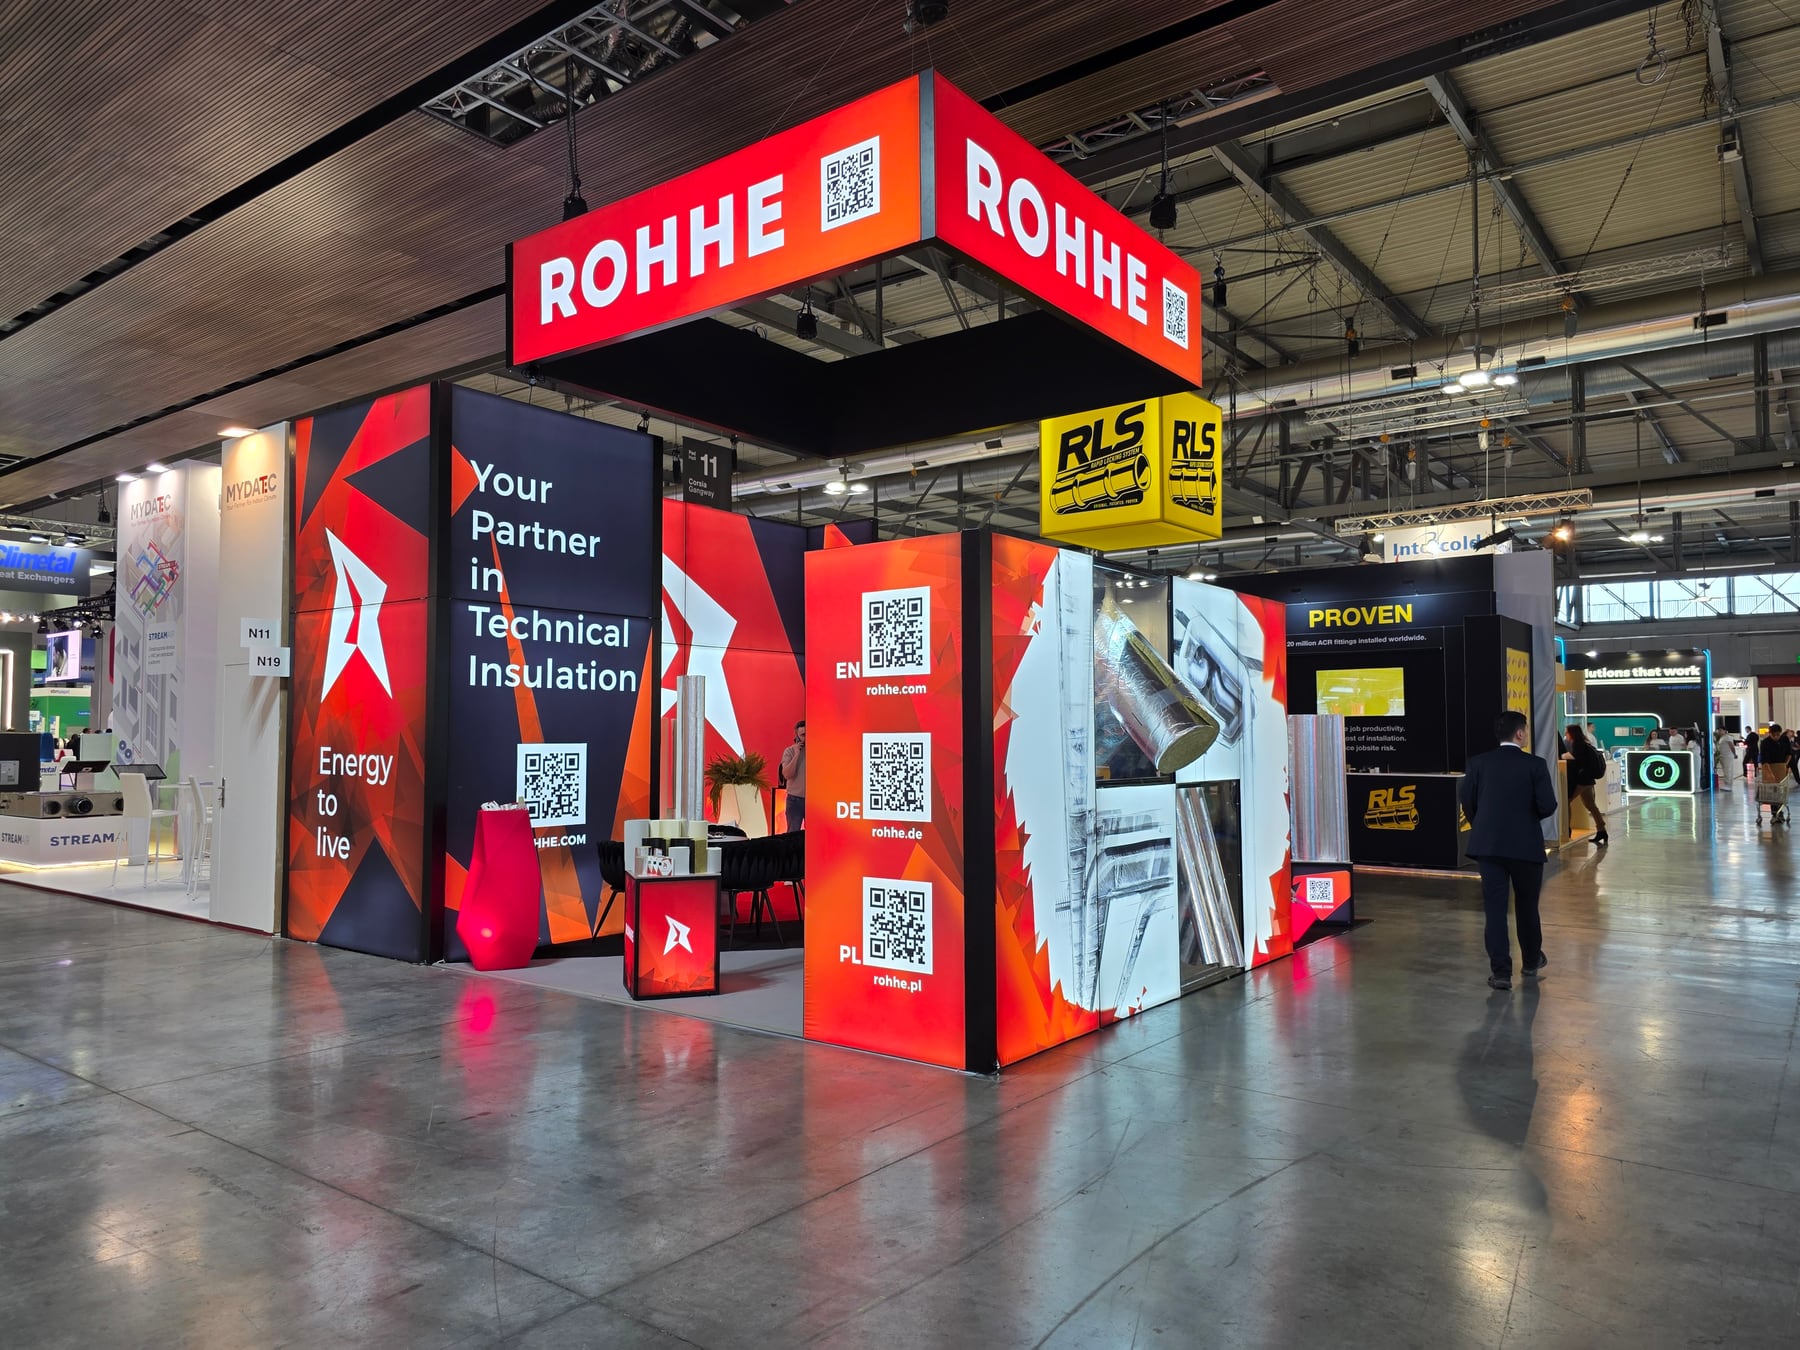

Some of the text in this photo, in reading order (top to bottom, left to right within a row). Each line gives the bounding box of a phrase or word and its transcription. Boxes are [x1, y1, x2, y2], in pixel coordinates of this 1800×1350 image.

[966, 138, 1148, 326] ROHHE
[540, 173, 785, 325] ROHHE
[1058, 403, 1146, 473] RLS
[1172, 420, 1216, 459] RLS
[700, 453, 718, 478] 11
[470, 459, 553, 503] Your
[471, 509, 601, 557] Partner
[17, 571, 75, 584] Exchangers
[470, 557, 504, 593] in
[468, 605, 630, 648] Technical
[1309, 604, 1413, 628] PROVEN
[248, 628, 270, 639] N11
[257, 656, 281, 667] N19
[469, 655, 637, 692] Insulation
[836, 661, 860, 679] EN
[1632, 666, 1661, 678] that
[1663, 665, 1700, 676] work
[866, 683, 927, 695] rohhe.com
[1362, 725, 1406, 733] productivity.
[319, 747, 393, 786] Energy
[317, 789, 338, 817] to
[1368, 785, 1417, 809] RLS
[836, 802, 861, 819] DE
[316, 826, 350, 860] live
[872, 826, 923, 840] rohhe.de
[839, 945, 861, 965] PL
[873, 974, 922, 992] rohhe.pl
